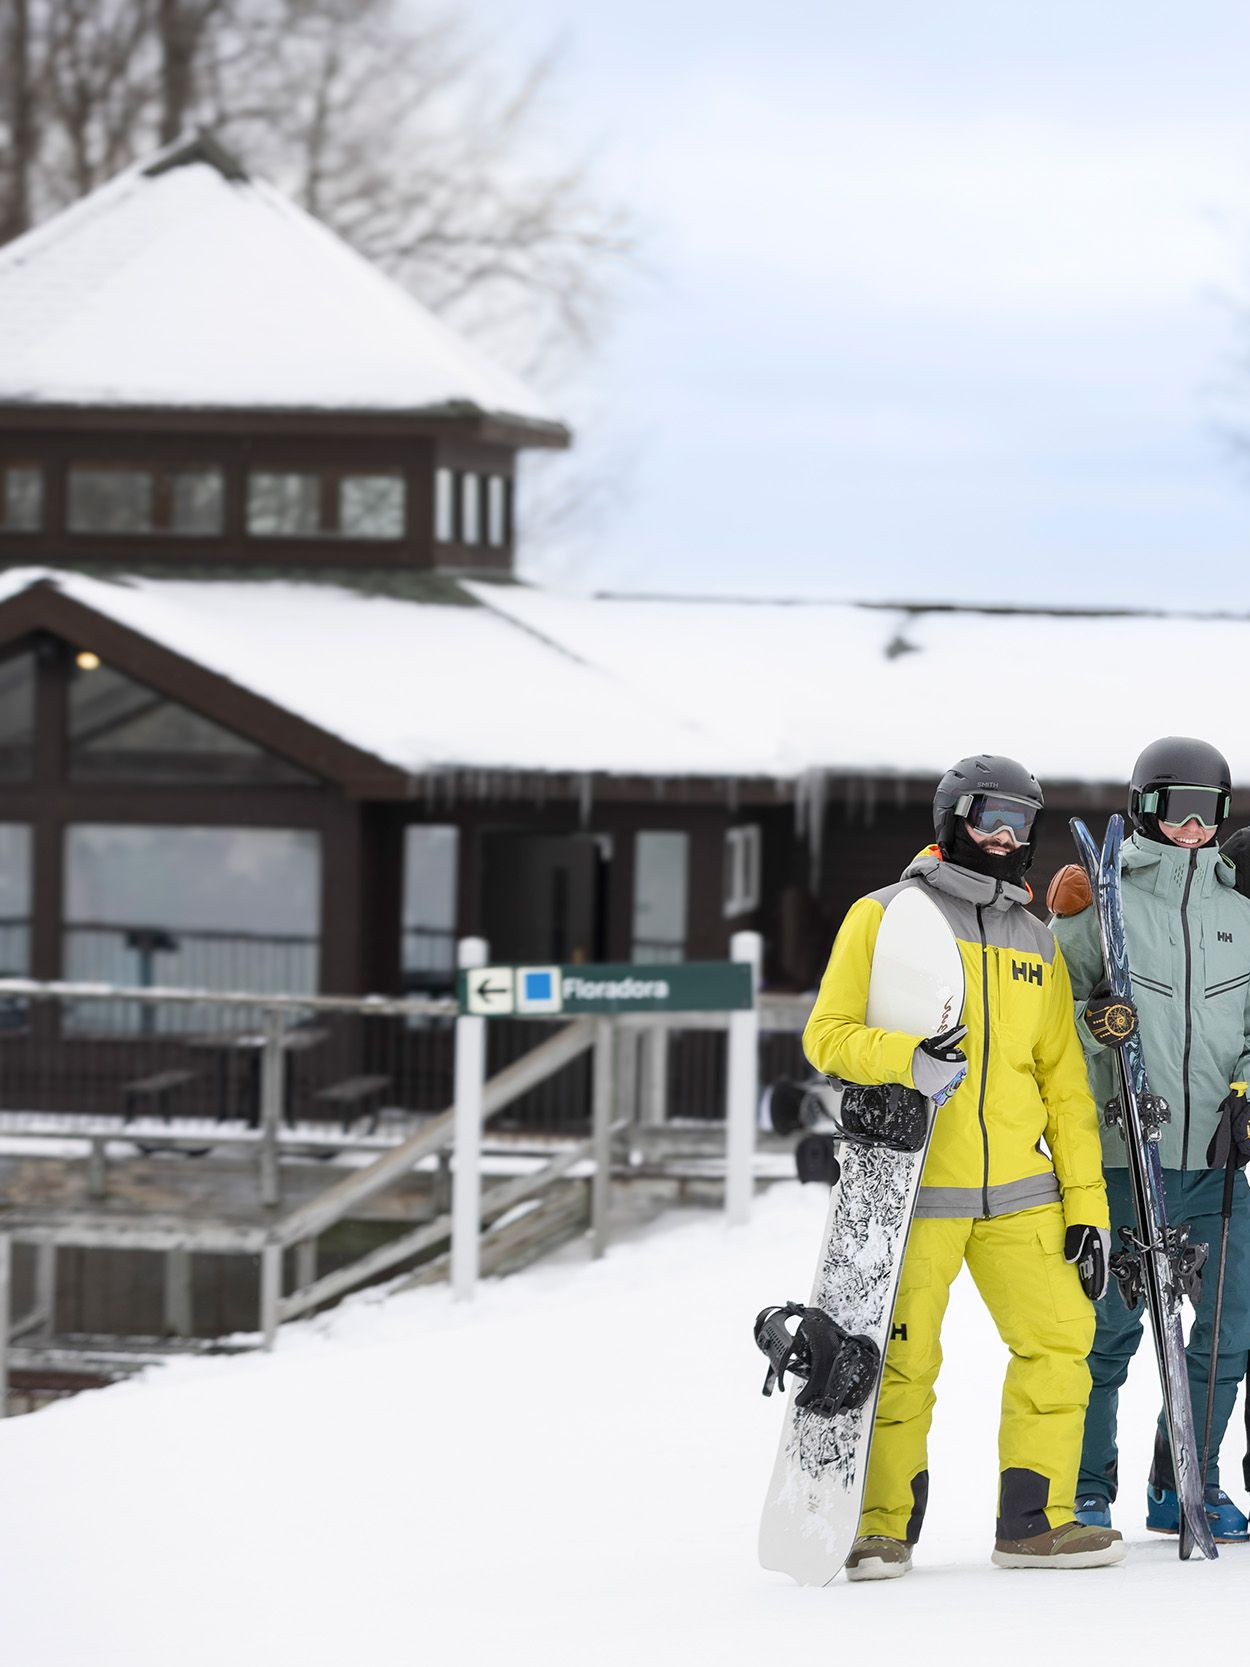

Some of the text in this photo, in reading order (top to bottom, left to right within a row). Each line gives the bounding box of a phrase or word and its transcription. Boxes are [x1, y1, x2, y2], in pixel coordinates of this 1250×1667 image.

[1217, 931, 1233, 943] HH
[1012, 958, 1043, 987] HH
[563, 977, 669, 1000] Floradora
[890, 1322, 908, 1341] H
